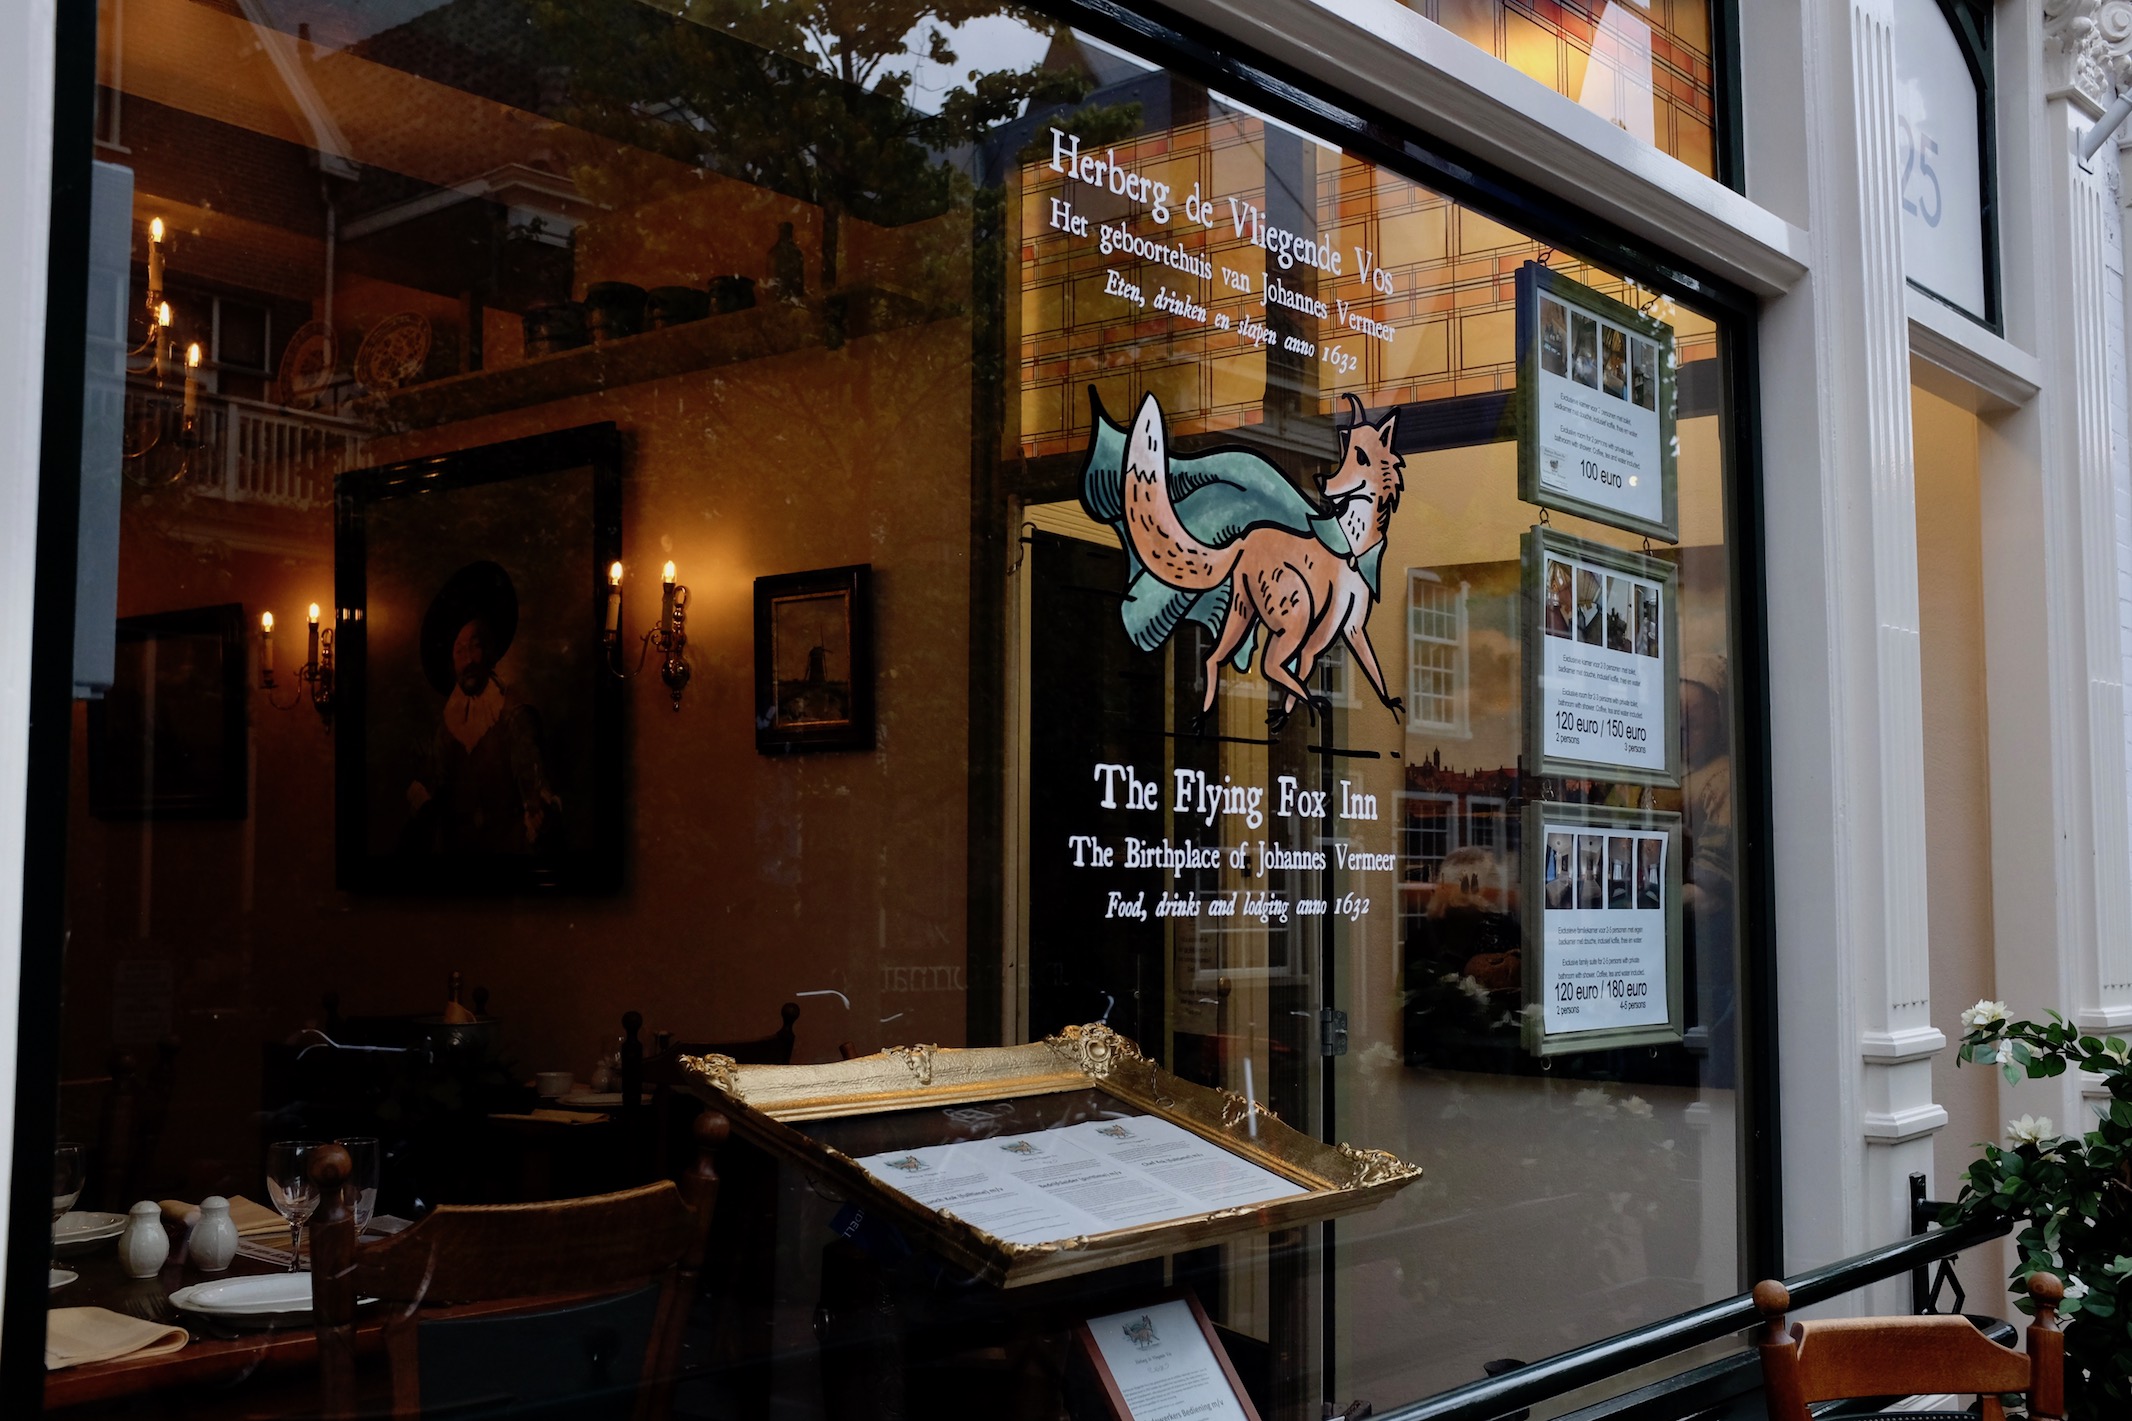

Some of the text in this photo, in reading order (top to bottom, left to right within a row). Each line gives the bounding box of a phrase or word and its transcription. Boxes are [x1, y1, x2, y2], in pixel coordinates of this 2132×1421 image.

[1049, 127, 1393, 294] Herberg de Vliegende Vos
[1050, 197, 1396, 343] Het geboortehuis van Johannes Vermeer
[1104, 270, 1357, 374] Eten, drinken en slapen anno 1632
[1580, 458, 1599, 482] 100
[1601, 469, 1622, 489] euro
[1556, 711, 1647, 742] 120 euro / 150 euro
[1556, 733, 1646, 754] 2 persons 3 persons
[1094, 763, 1378, 829] The Flying Fox Inn
[1069, 835, 1396, 877] The Birthplace of Johannes Vermeer
[1105, 891, 1370, 923] Food, drinks and lodging anno 1632
[1554, 979, 1647, 1002] 120 euro / 180 euro
[1557, 1006, 1560, 1015] 2
[1561, 1006, 1580, 1016] persons
[1628, 1001, 1646, 1010] persons
[1181, 1403, 1212, 1417] Bediening
[1211, 1398, 1224, 1409] m/v
